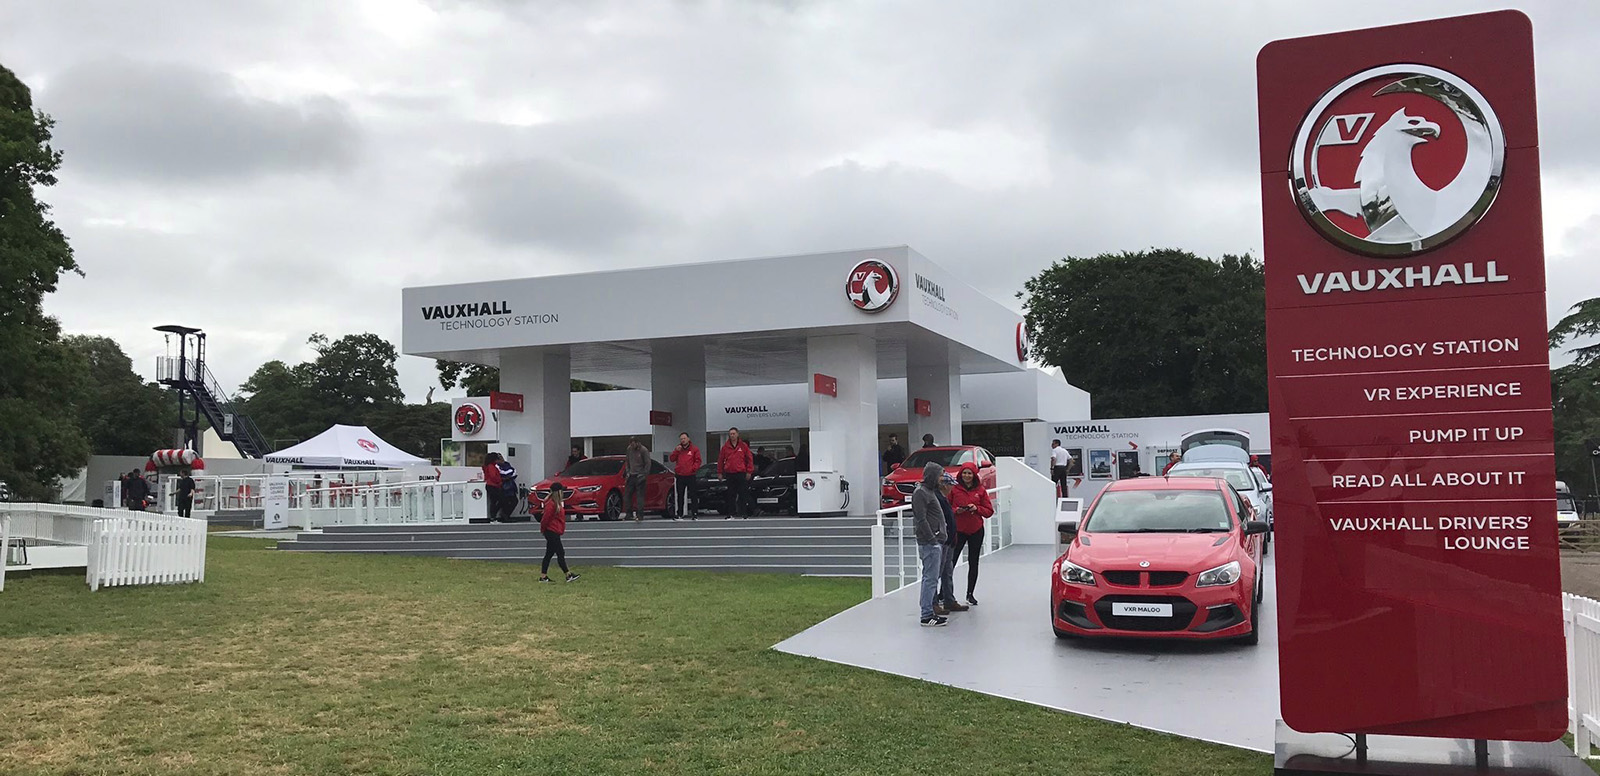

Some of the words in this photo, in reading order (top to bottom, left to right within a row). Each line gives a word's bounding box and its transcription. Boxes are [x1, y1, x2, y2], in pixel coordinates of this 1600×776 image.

[1336, 118, 1367, 141] V
[1297, 261, 1509, 294] VAUXHALL
[915, 273, 946, 303] VAUXHALL
[422, 301, 512, 320] VAUXHALL
[440, 317, 512, 331] TECHNOLOGY
[514, 313, 559, 326] STATION
[1292, 343, 1427, 362] TECHNOLOGY
[1432, 338, 1519, 355] STATION
[1364, 388, 1391, 401] VR
[1396, 382, 1522, 400] EXPERIENCE
[724, 405, 769, 414] VAUXHALL
[1053, 425, 1110, 434] VAUXHALL
[1409, 428, 1468, 443] PUMP
[1473, 427, 1490, 441] IT
[1495, 427, 1524, 440] UP
[265, 456, 304, 464] VAUXHALL
[1332, 475, 1385, 488] READ
[1390, 474, 1427, 487] ALL
[1432, 472, 1502, 486] ABOUT
[1508, 471, 1526, 485] IT
[1330, 517, 1433, 531] VAUXHALL
[1438, 516, 1531, 530] DRIVERS'
[1444, 536, 1530, 550] LOUNGE
